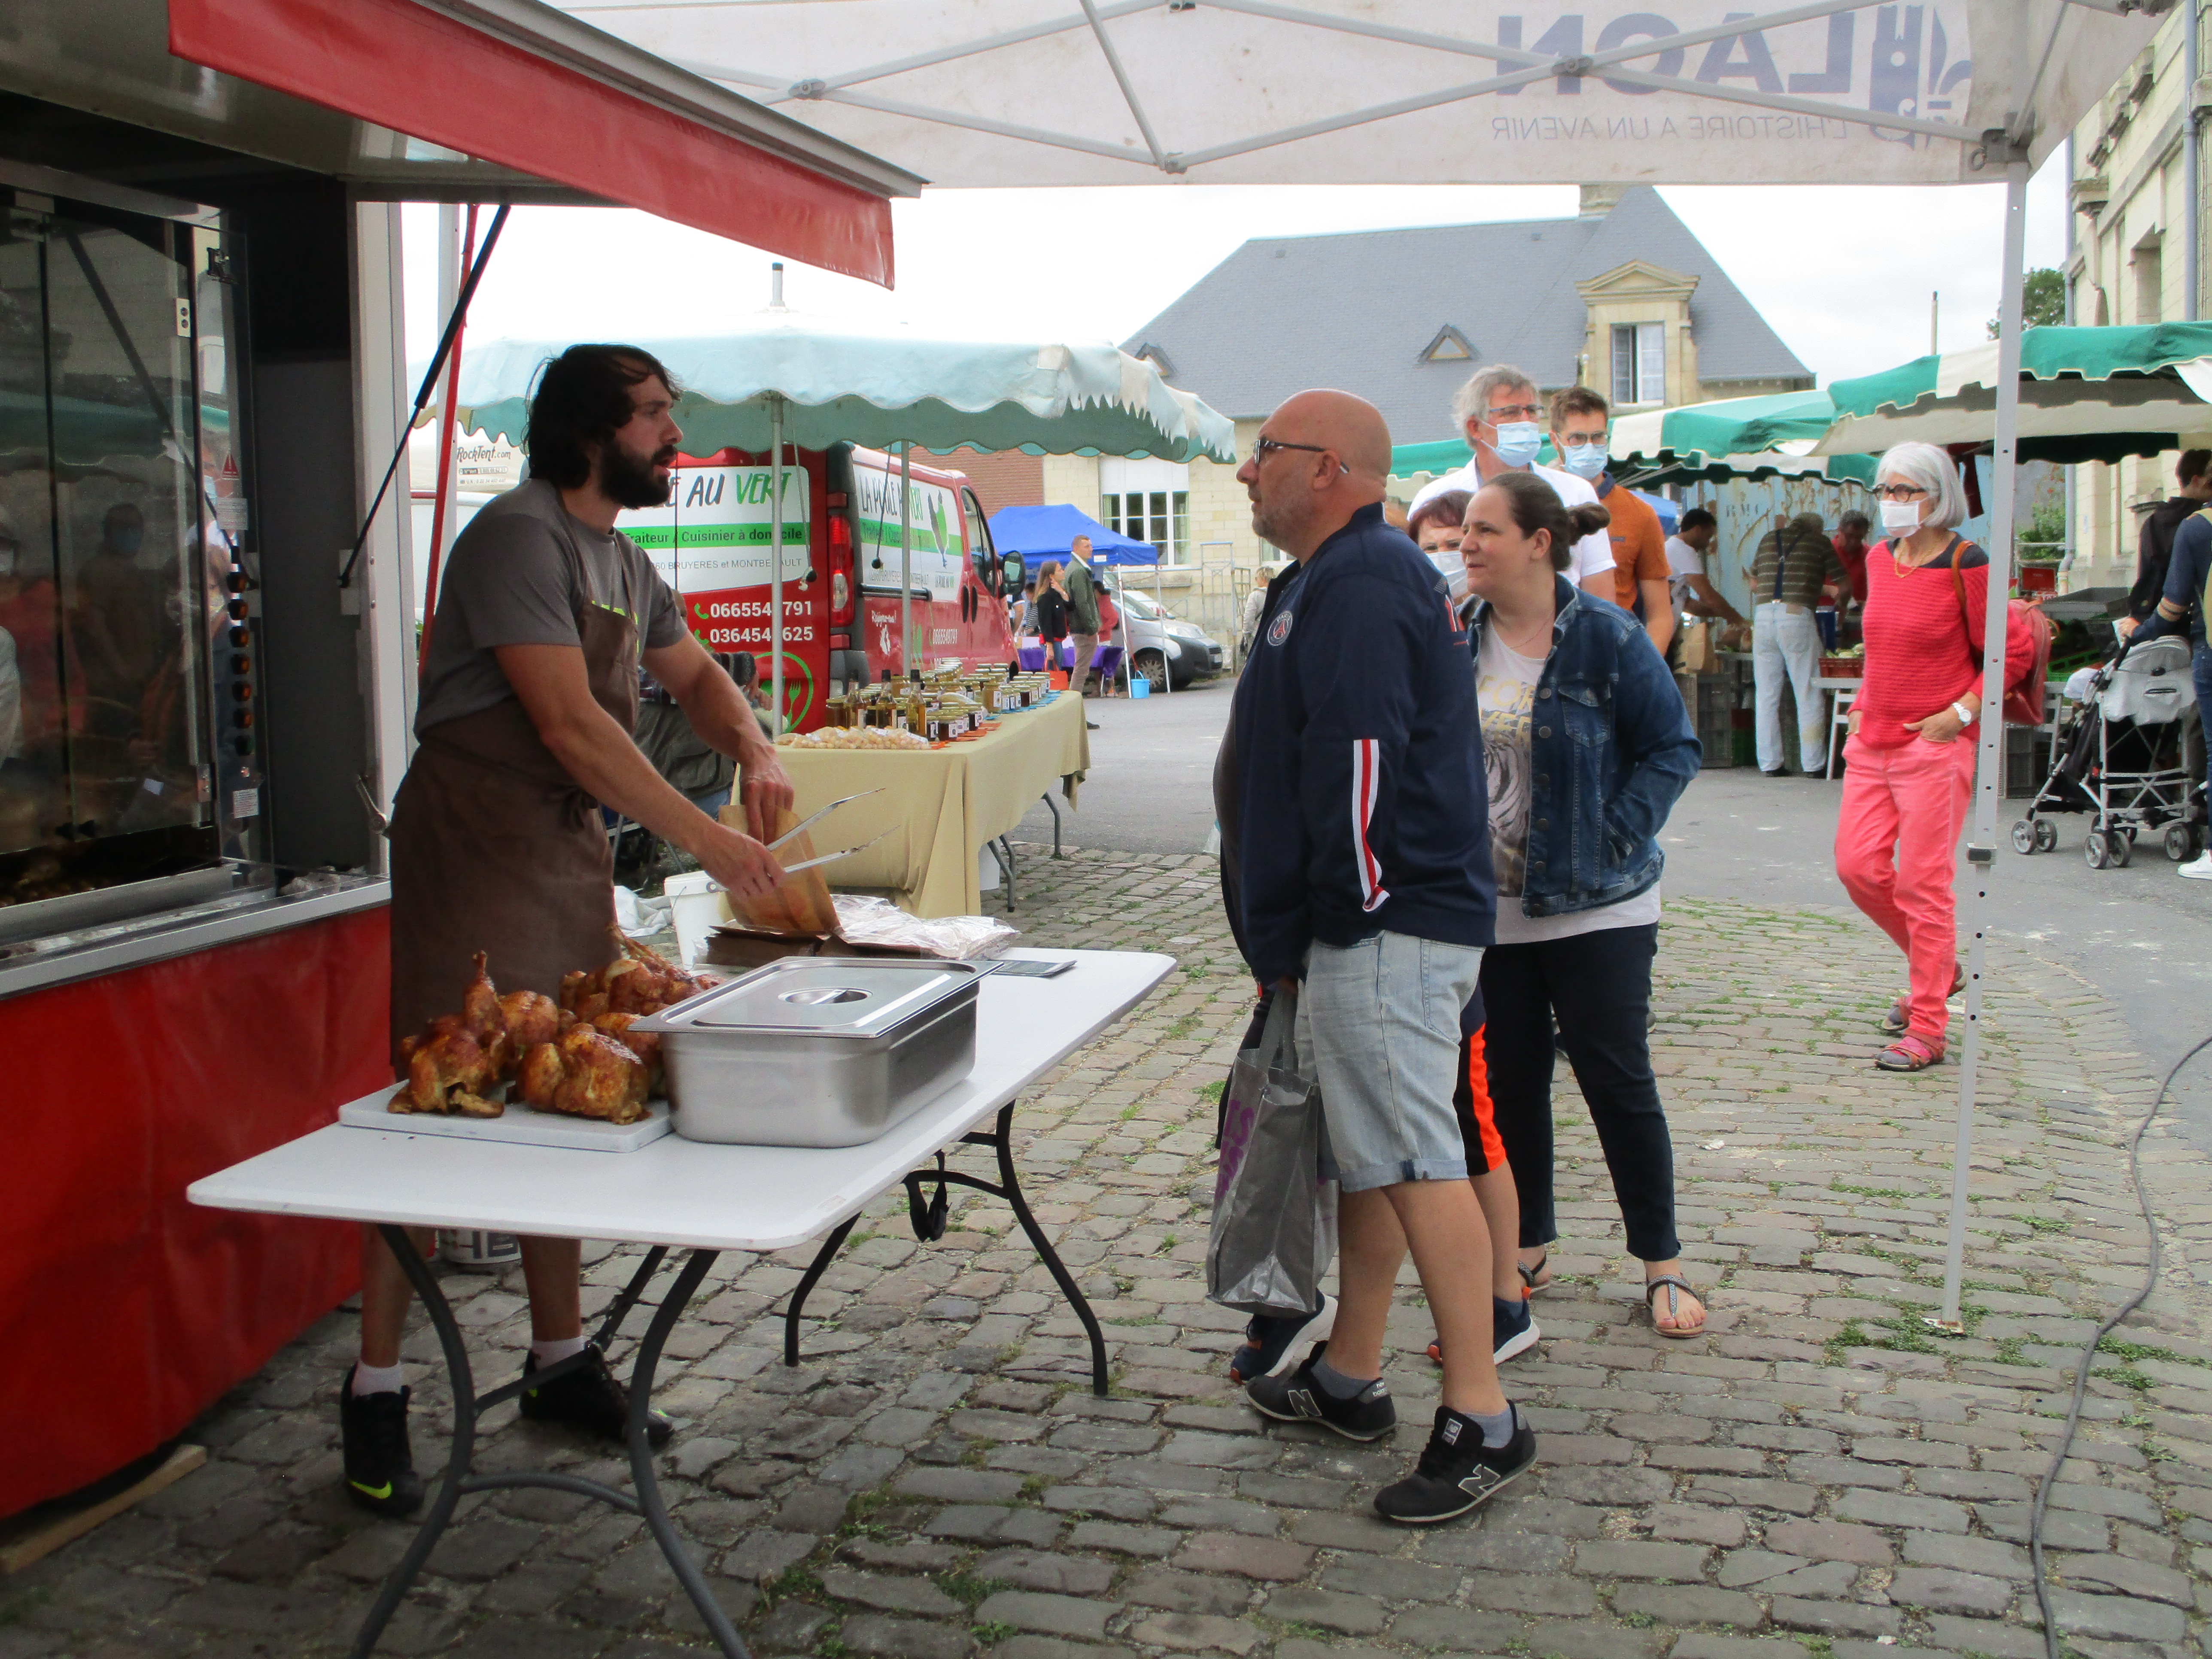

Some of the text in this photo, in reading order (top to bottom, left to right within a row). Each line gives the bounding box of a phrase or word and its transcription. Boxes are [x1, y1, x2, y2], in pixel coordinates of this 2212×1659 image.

[686, 473, 725, 508] AU
[860, 474, 872, 514] LA
[682, 529, 735, 542] Cuisinier
[738, 529, 746, 540] à
[749, 528, 802, 540] domcile
[668, 560, 718, 570] BRUYERES
[710, 601, 812, 618] 066554791
[709, 626, 813, 643] 036454625
